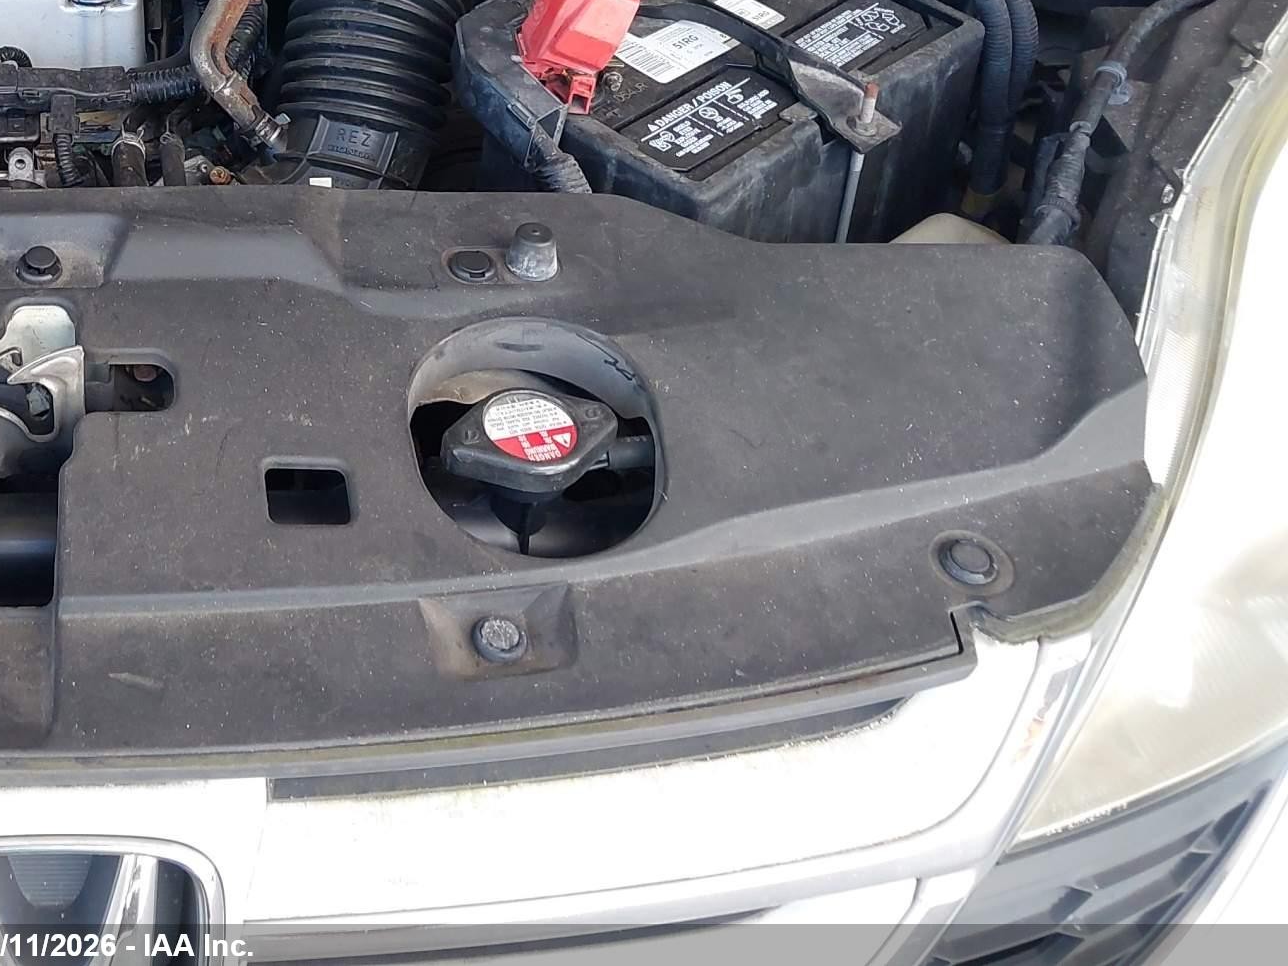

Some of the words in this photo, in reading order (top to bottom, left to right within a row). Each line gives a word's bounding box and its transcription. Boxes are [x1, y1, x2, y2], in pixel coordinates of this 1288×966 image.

[672, 34, 699, 50] 51RG
[655, 102, 694, 128] DANGER
[696, 81, 733, 103] POISON
[336, 128, 372, 148] REZ
